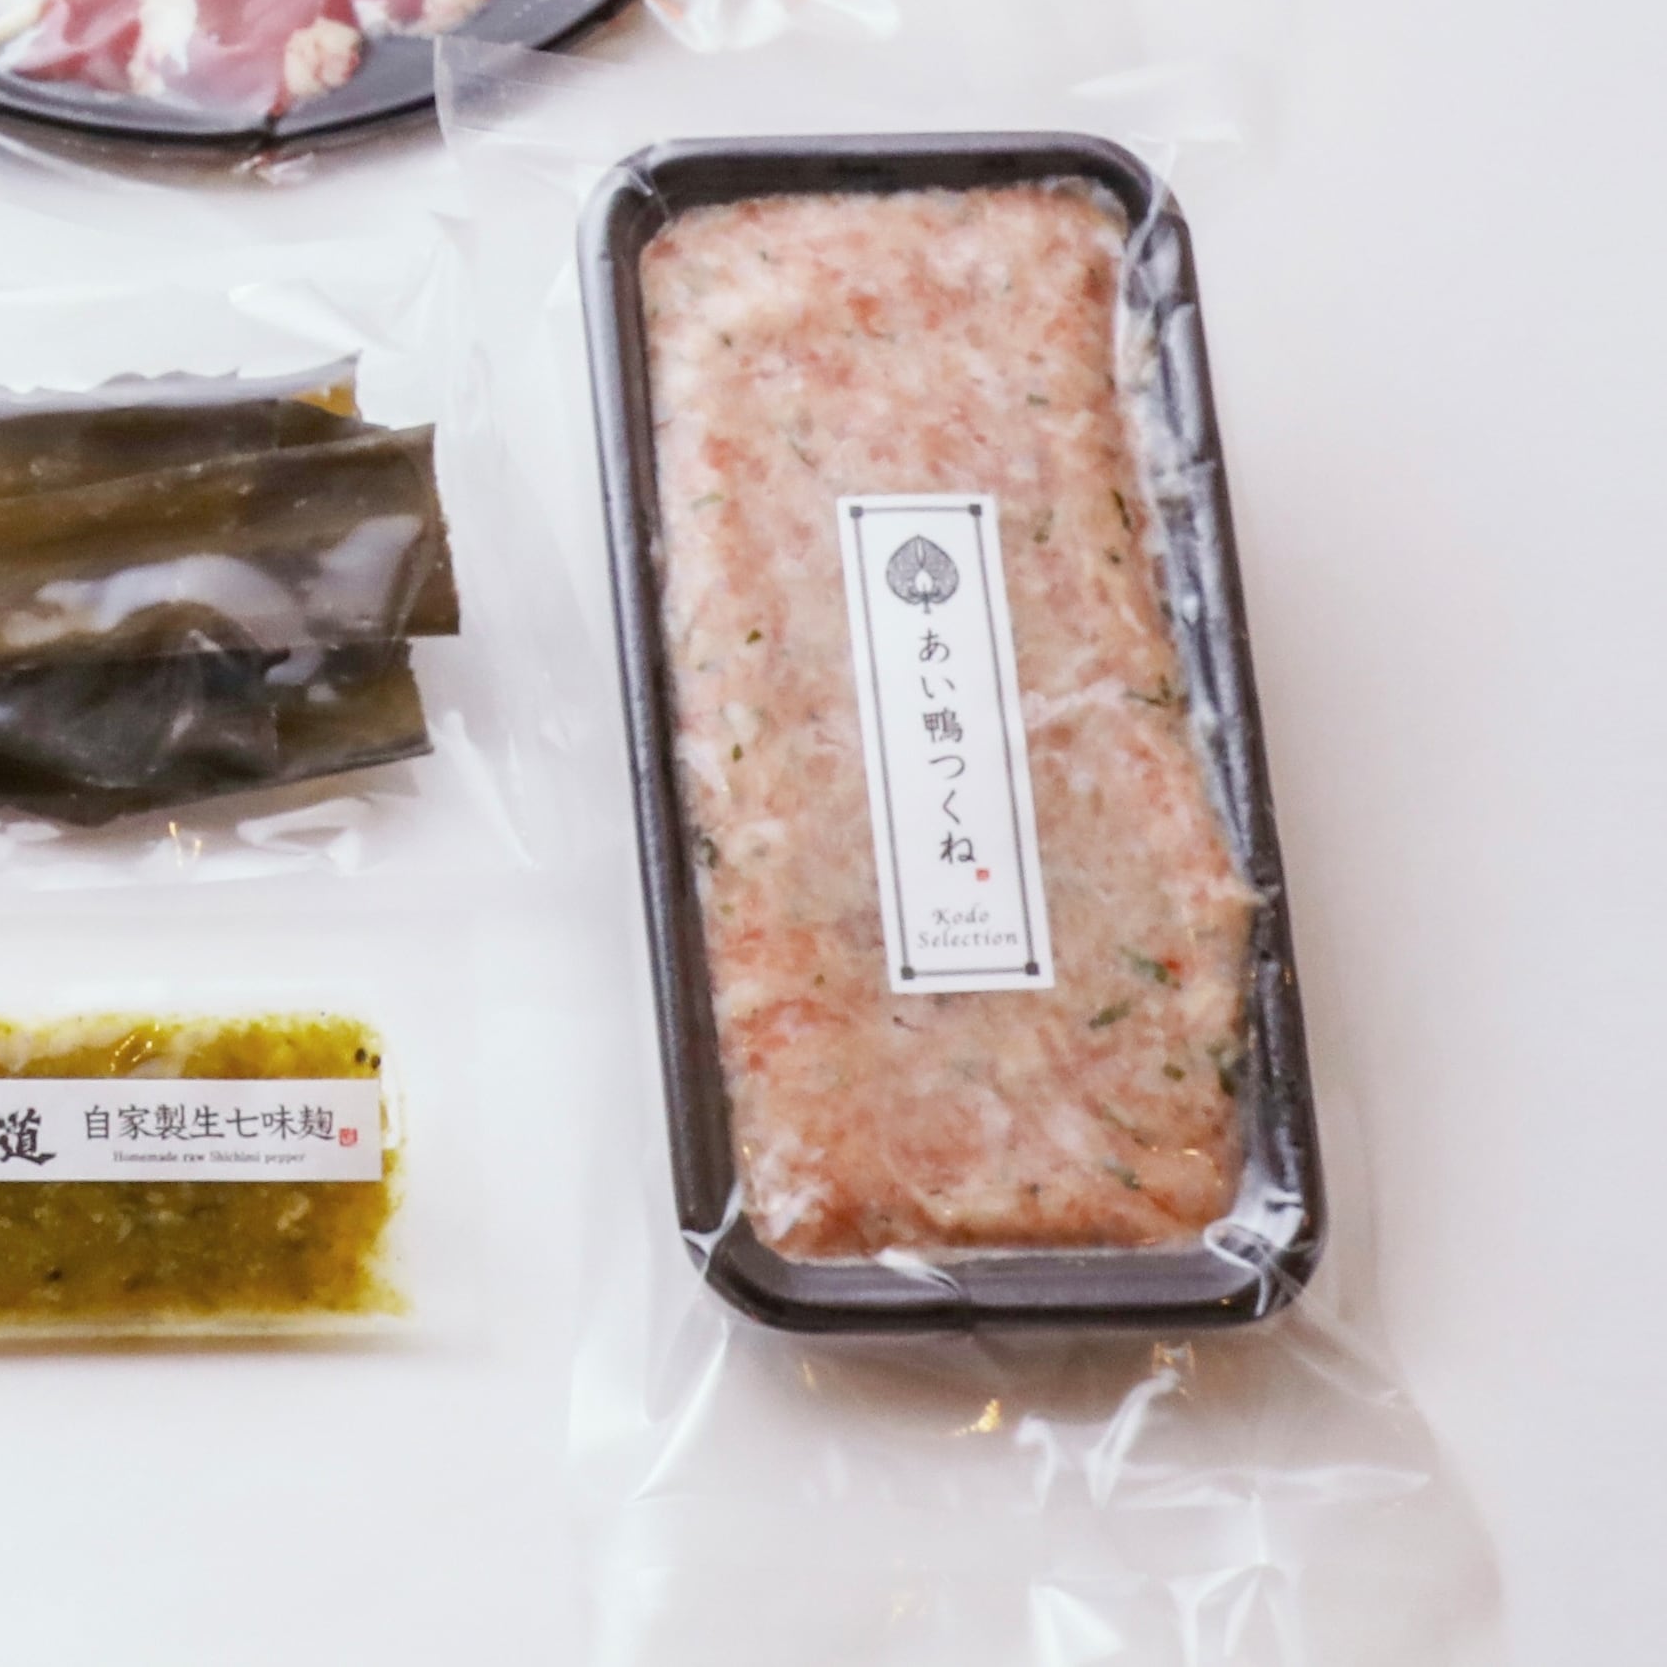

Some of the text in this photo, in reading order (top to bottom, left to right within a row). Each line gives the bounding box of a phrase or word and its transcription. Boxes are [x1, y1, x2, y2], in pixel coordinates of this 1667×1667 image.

[918, 628, 976, 865] あい鴨つくね
[932, 903, 989, 926] Kodo
[918, 926, 1018, 950] Selection
[84, 1104, 336, 1141] 自家製生七味麹
[113, 1151, 306, 1165] Homemade raw Shichimi pepper
